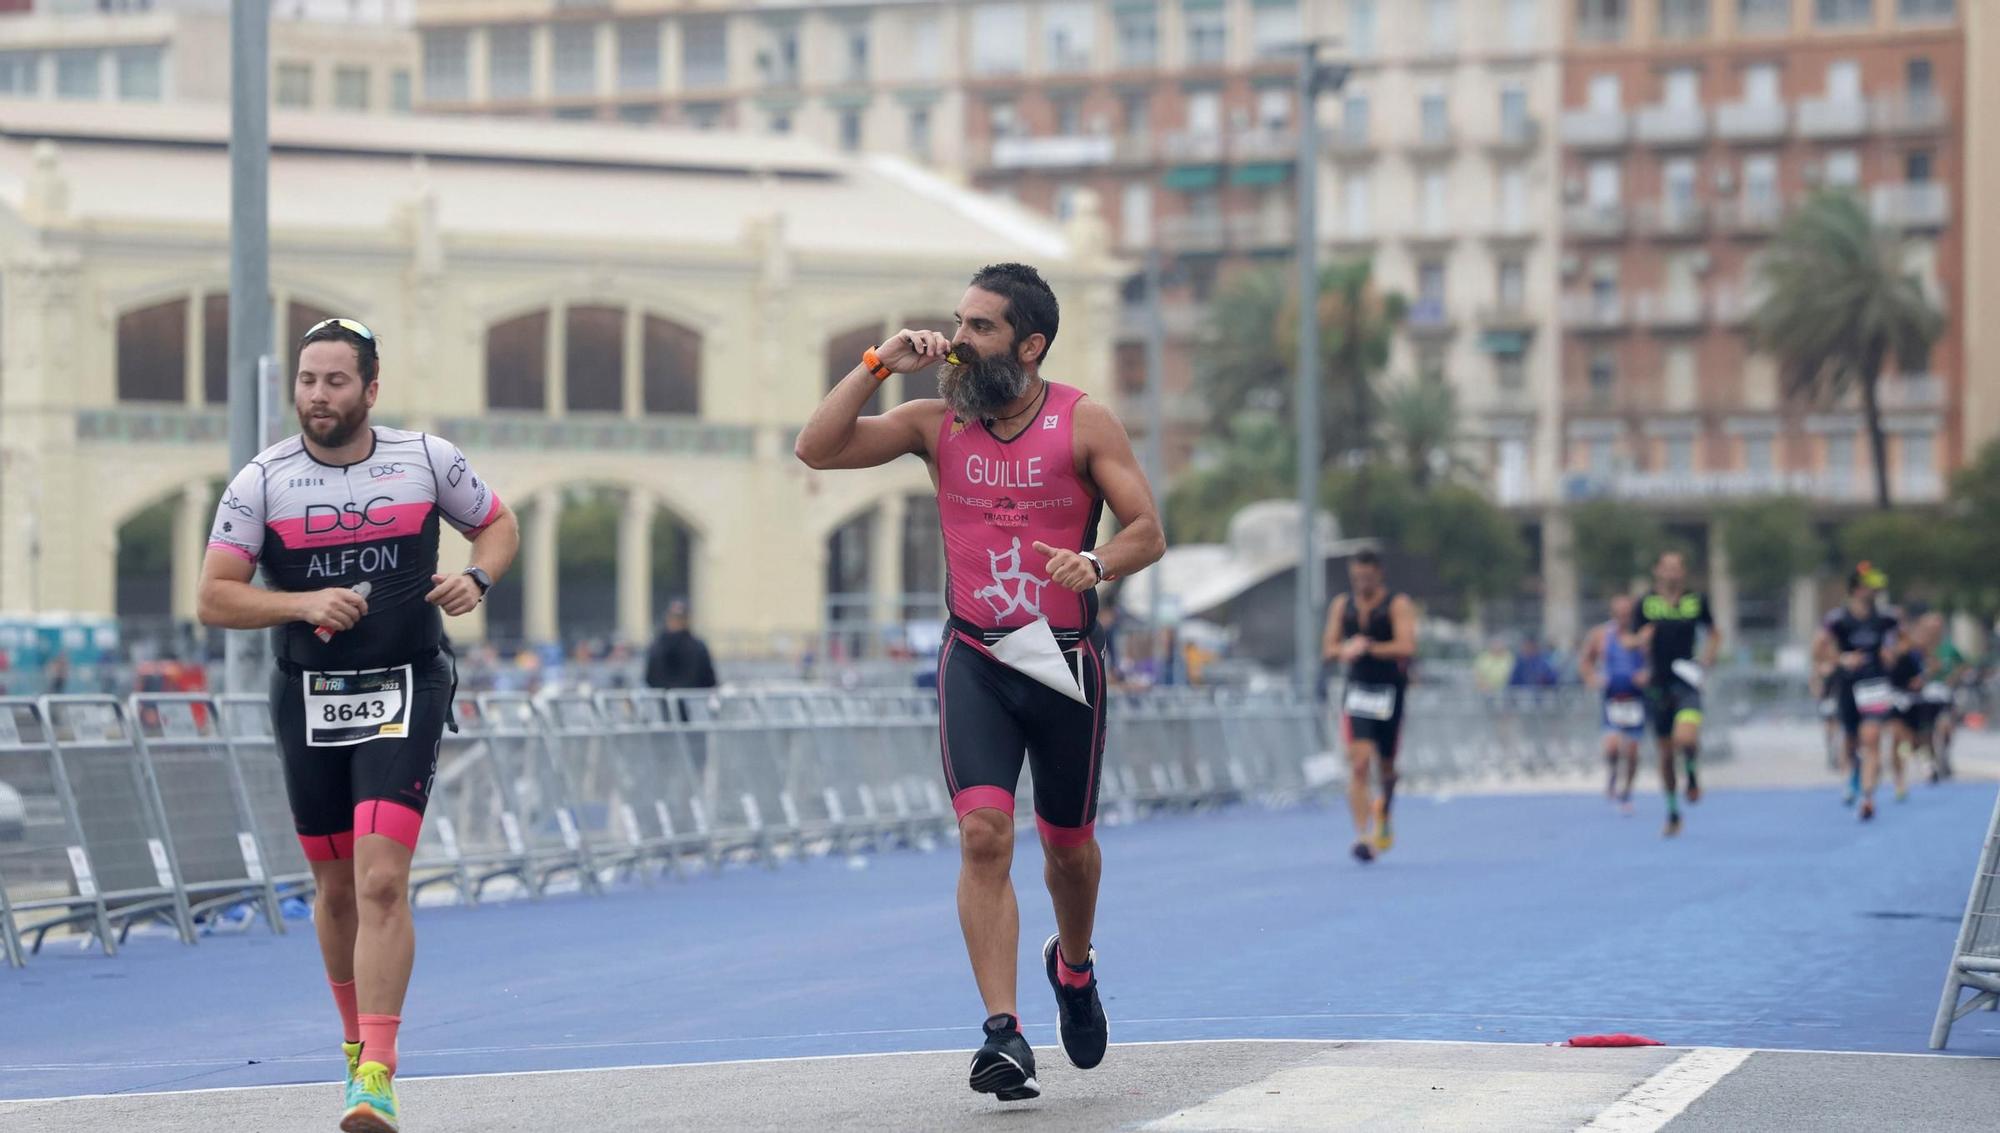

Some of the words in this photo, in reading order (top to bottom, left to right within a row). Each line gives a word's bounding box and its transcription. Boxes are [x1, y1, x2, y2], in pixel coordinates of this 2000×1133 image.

[369, 462, 405, 478] DSC
[966, 454, 1044, 488] GUILLE
[946, 493, 993, 509] FITNESS
[1017, 497, 1073, 510] SPORTS
[304, 496, 397, 535] DSC
[983, 512, 1029, 521] TRIATLON
[306, 544, 399, 578] ALFON
[322, 700, 386, 723] 8643
